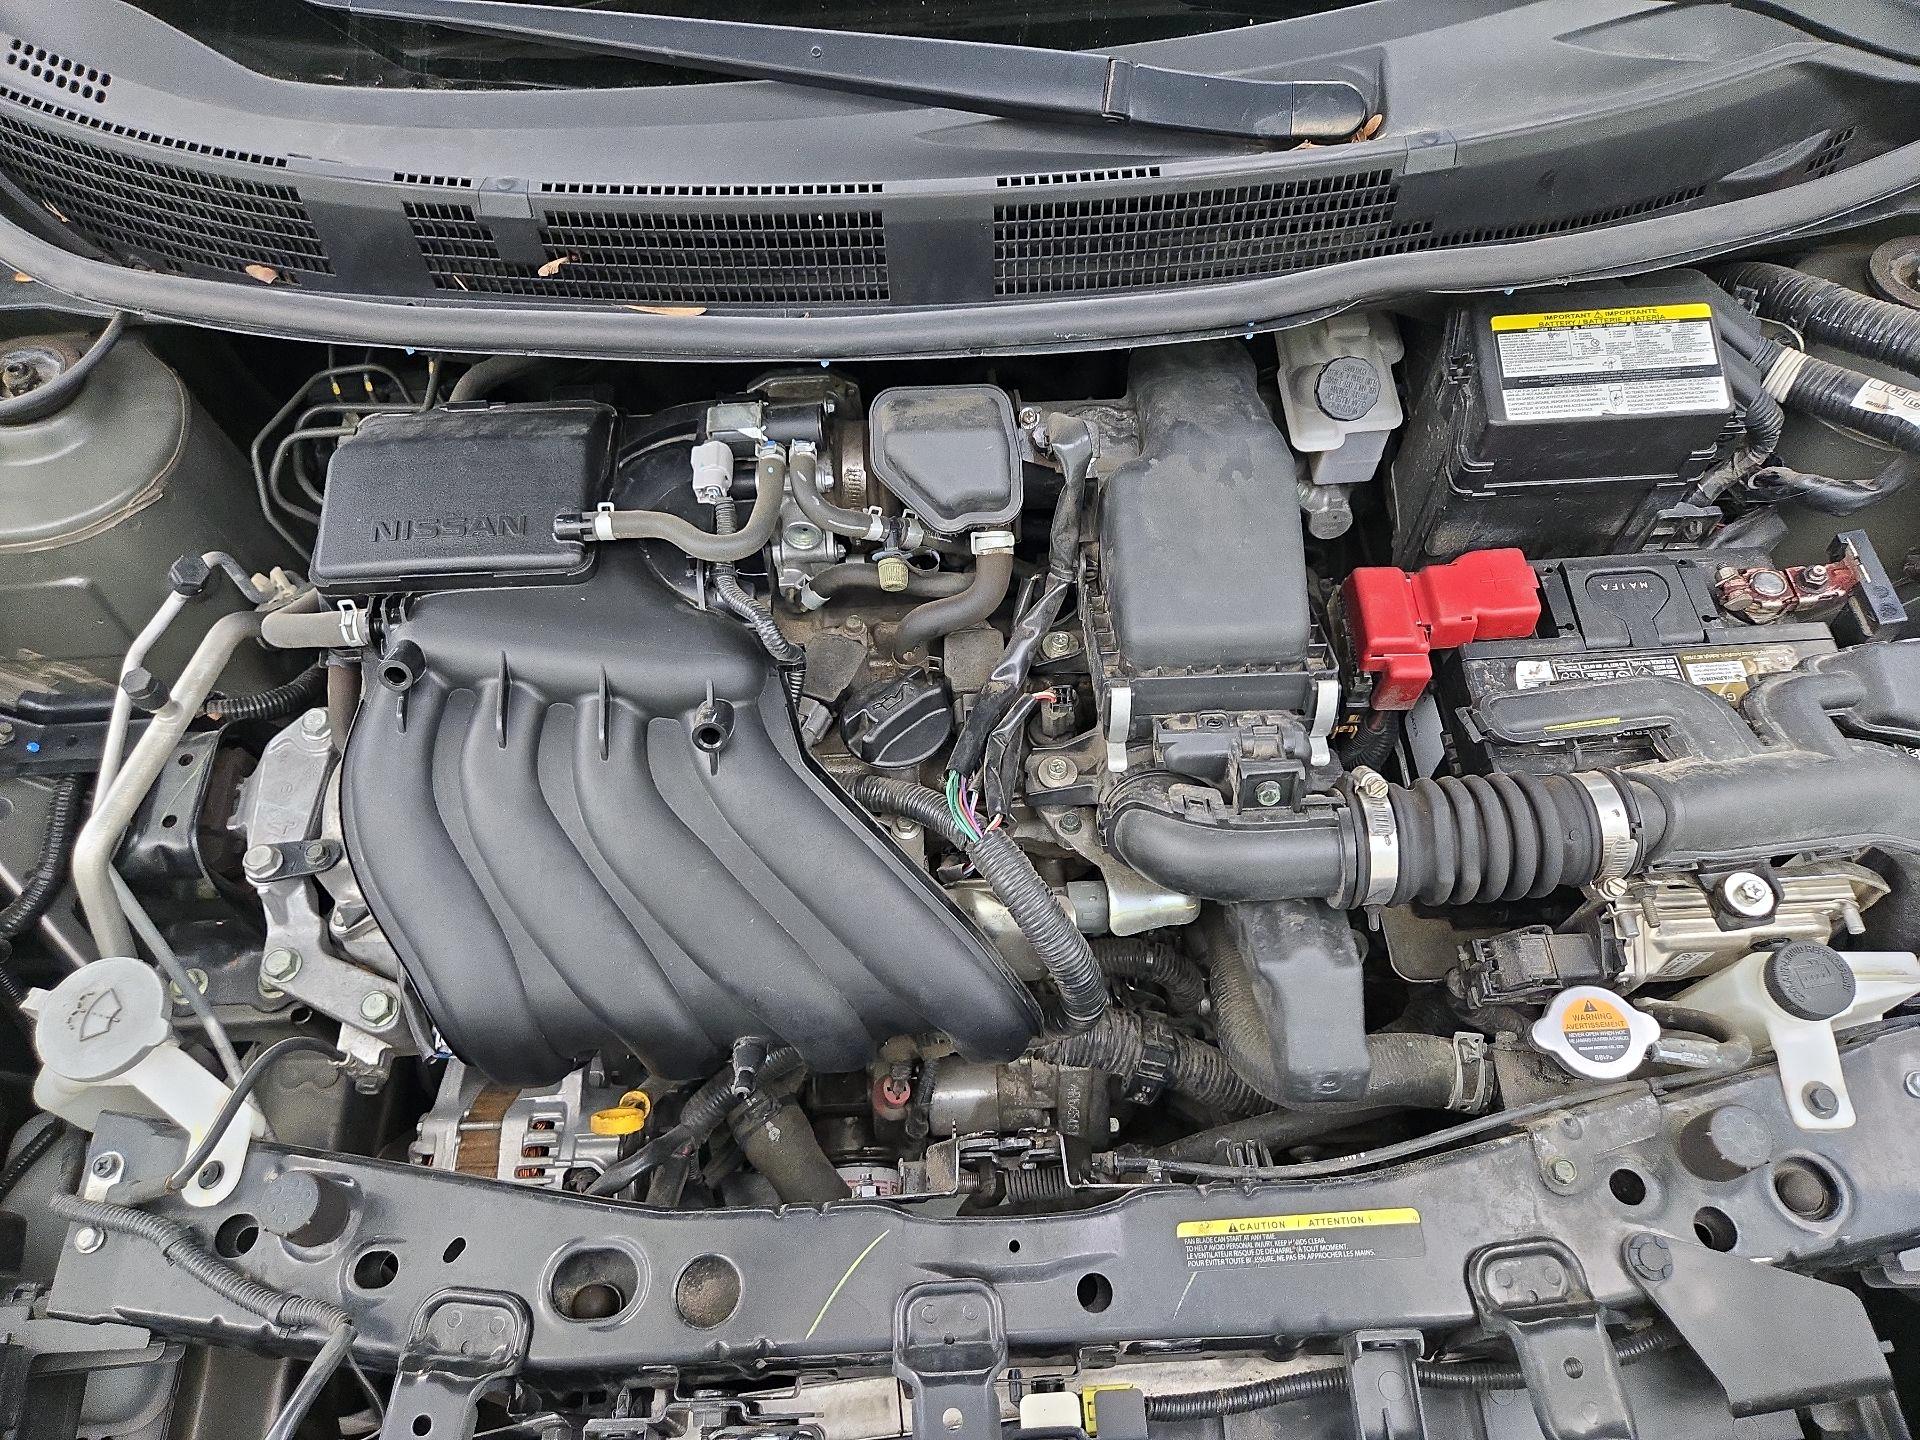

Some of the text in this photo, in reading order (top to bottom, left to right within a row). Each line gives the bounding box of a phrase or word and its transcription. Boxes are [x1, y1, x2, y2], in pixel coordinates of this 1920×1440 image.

[1544, 309, 1658, 321] IMPORTANT IMPORTANTE
[1539, 319, 1576, 327] BATTERY
[1583, 317, 1622, 325] BATTERIE
[371, 514, 527, 542] NISSAN
[1572, 1013, 1612, 1021] WARNING
[1566, 1020, 1624, 1030] AVERTISSEMENT
[1239, 1221, 1286, 1232] CAUTION
[1308, 1216, 1364, 1227] ATTENTION
[1196, 1236, 1213, 1244] BLADE
[1226, 1241, 1254, 1250] PERSONAL
[1186, 1252, 1194, 1260] LE
[1194, 1250, 1233, 1259] VENTILATEUR
[1233, 1248, 1255, 1257] RISQUE
[1187, 1259, 1204, 1267] POUR
[1225, 1257, 1246, 1265] TOUTE
[1277, 1254, 1286, 1262] NE
[1286, 1253, 1298, 1261] PAS
[1298, 1252, 1307, 1260] EN
[1307, 1250, 1343, 1260] APPROCHER
[1343, 1249, 1354, 1258] LES
